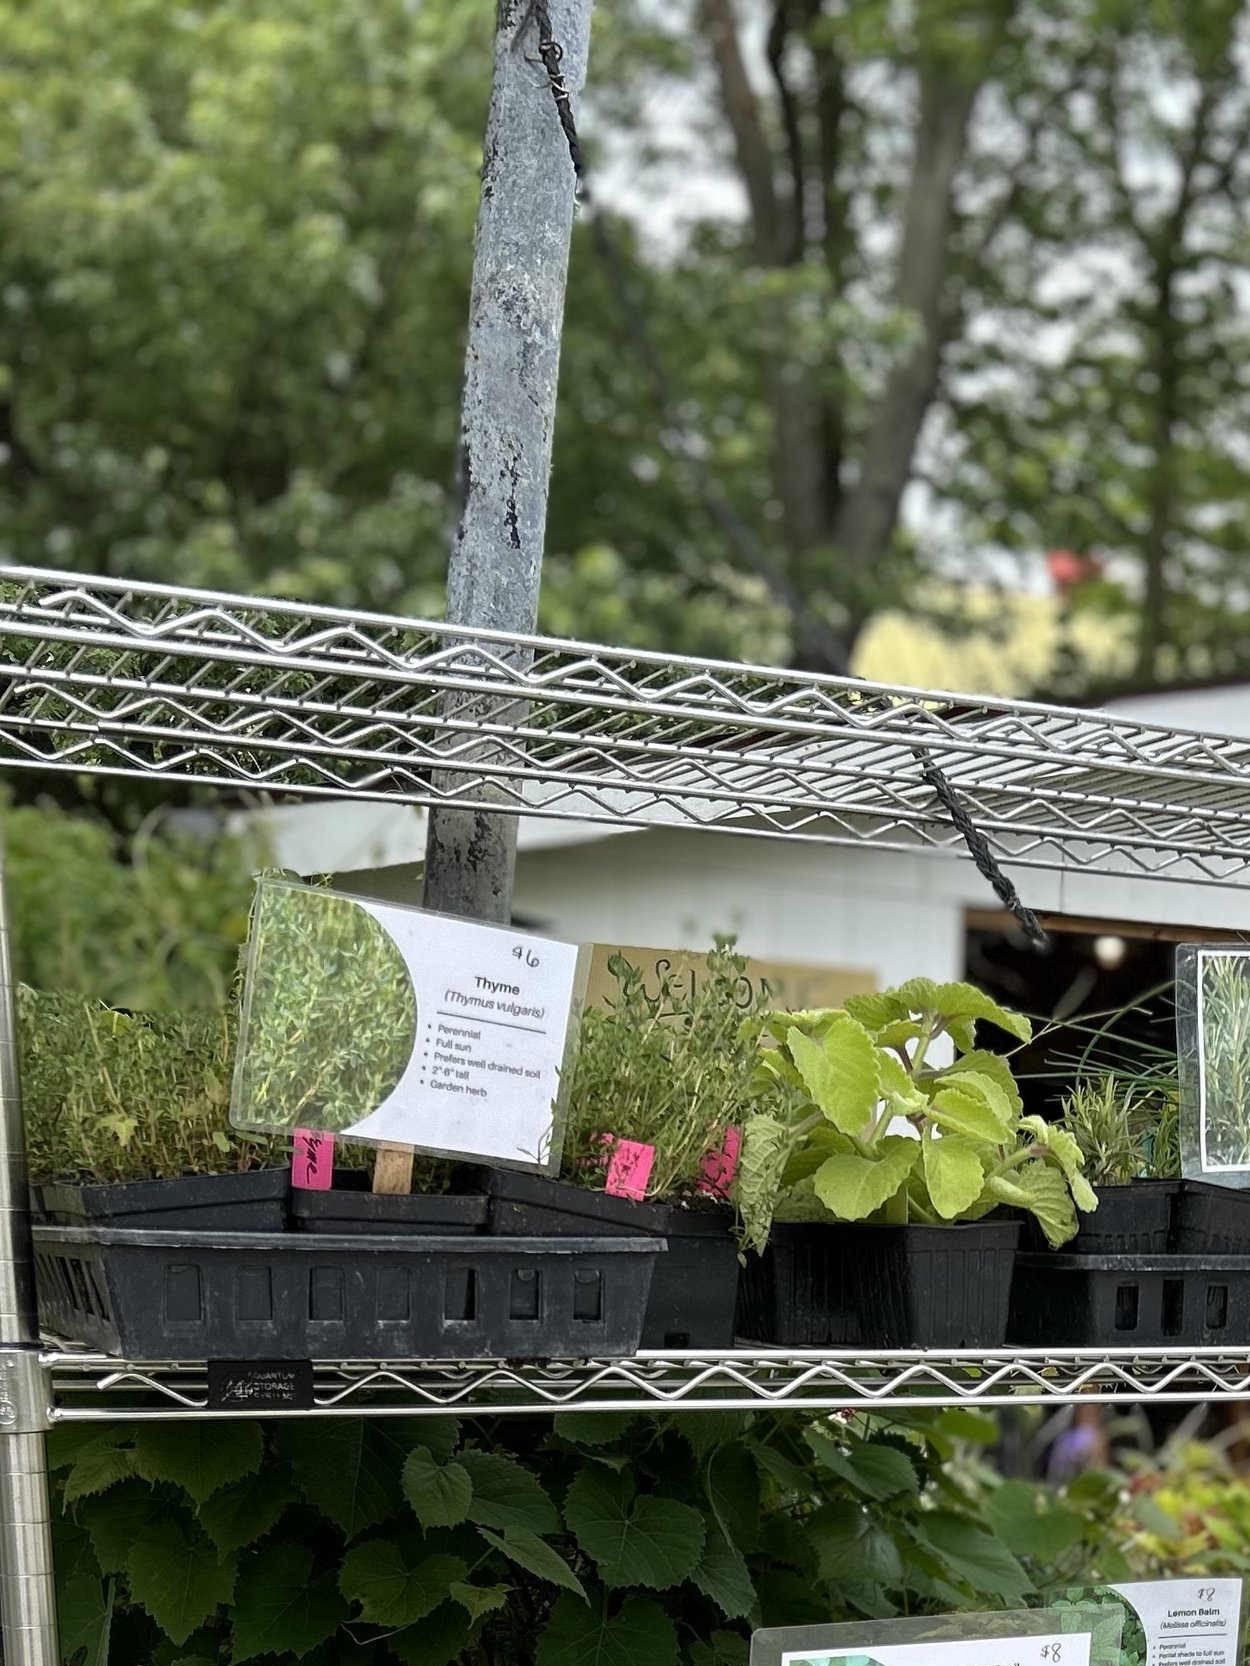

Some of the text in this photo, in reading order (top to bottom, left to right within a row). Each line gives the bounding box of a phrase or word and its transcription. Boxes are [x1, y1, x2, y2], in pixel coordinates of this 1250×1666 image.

[474, 976, 520, 995] Thyme
[444, 988, 545, 1019] (Thymus vulgaris)
[437, 1023, 481, 1040] Perennial
[435, 1037, 472, 1052] Full sun
[433, 1051, 540, 1079] Prefers well drained soil
[455, 1069, 469, 1080] tall
[429, 1079, 487, 1097] Garden herb
[1167, 1607, 1220, 1617] Lemon Balm
[1160, 1618, 1226, 1630] (Melissa officinalis)
[1040, 1642, 1061, 1663] $8
